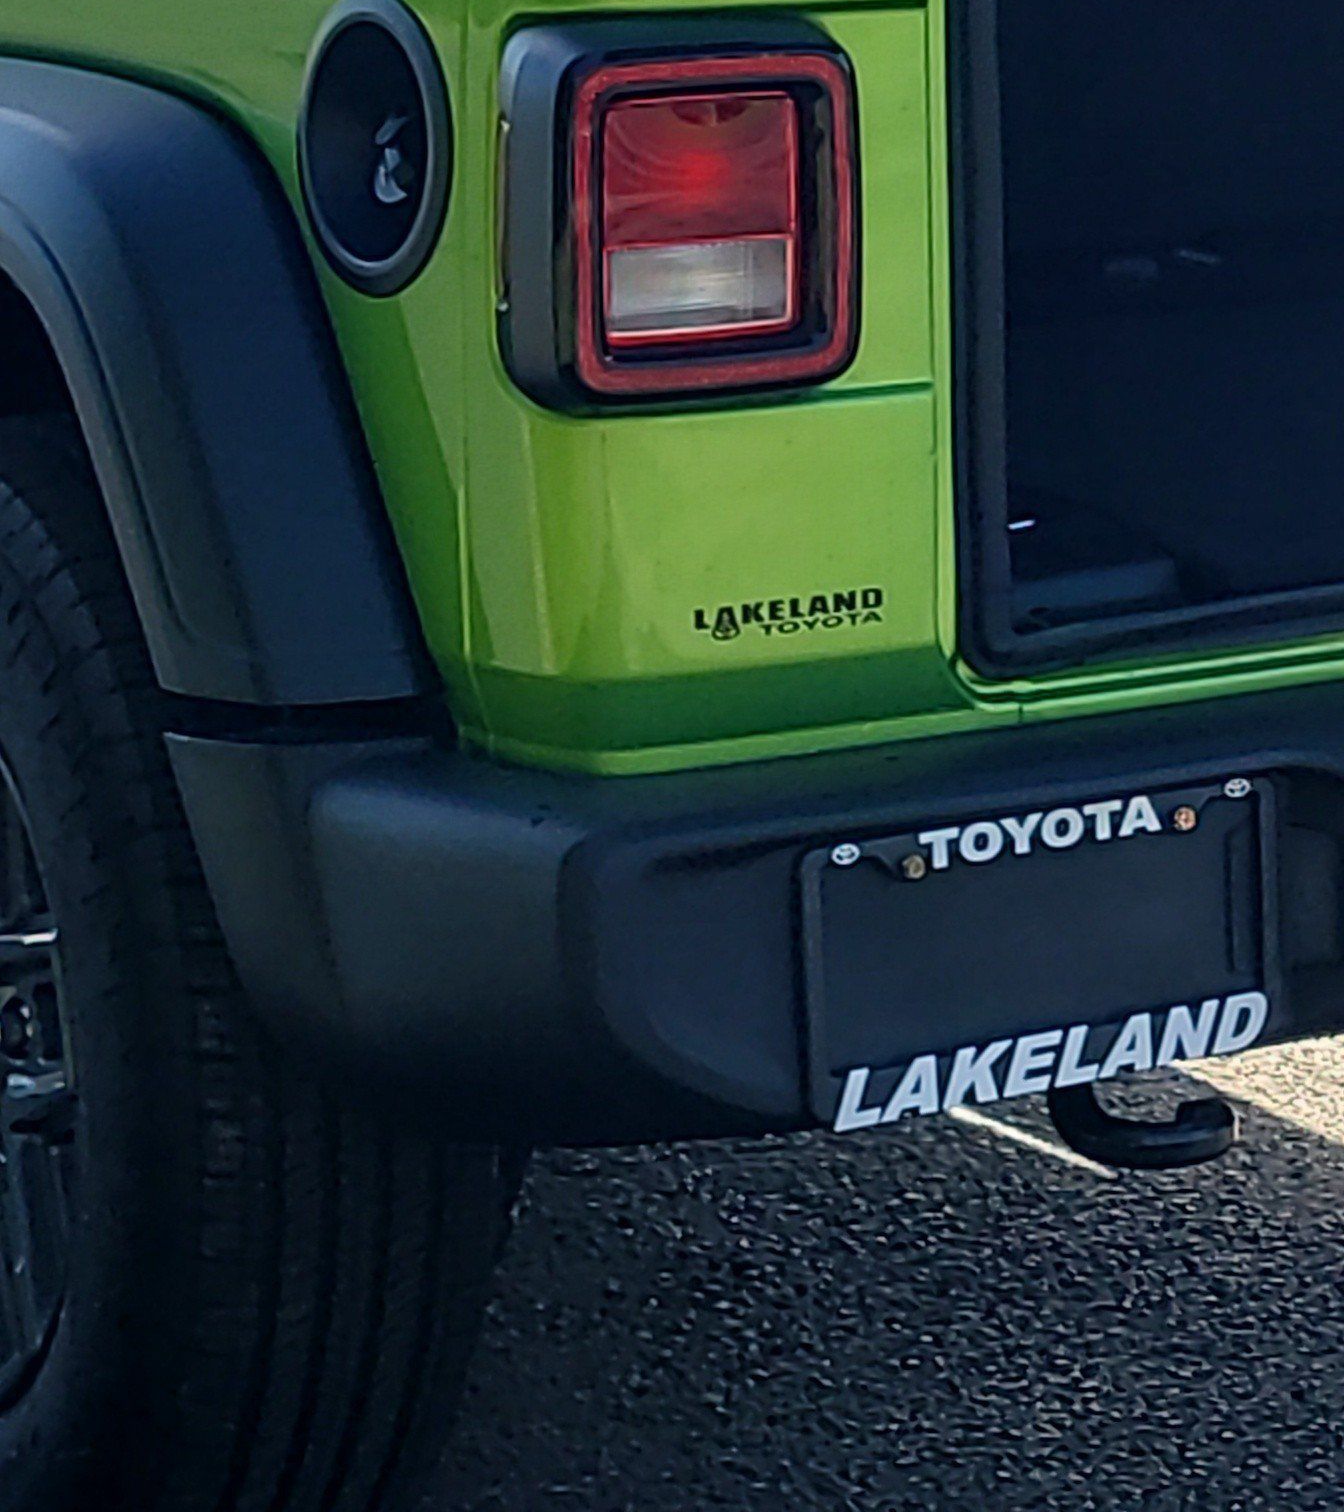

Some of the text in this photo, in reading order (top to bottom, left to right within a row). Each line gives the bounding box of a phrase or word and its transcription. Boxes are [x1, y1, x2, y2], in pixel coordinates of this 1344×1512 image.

[694, 588, 883, 640] LAKELAND
[760, 611, 883, 635] TOYOTA
[919, 795, 1162, 869] TOYOTA
[834, 991, 1268, 1133] LAKELAND
